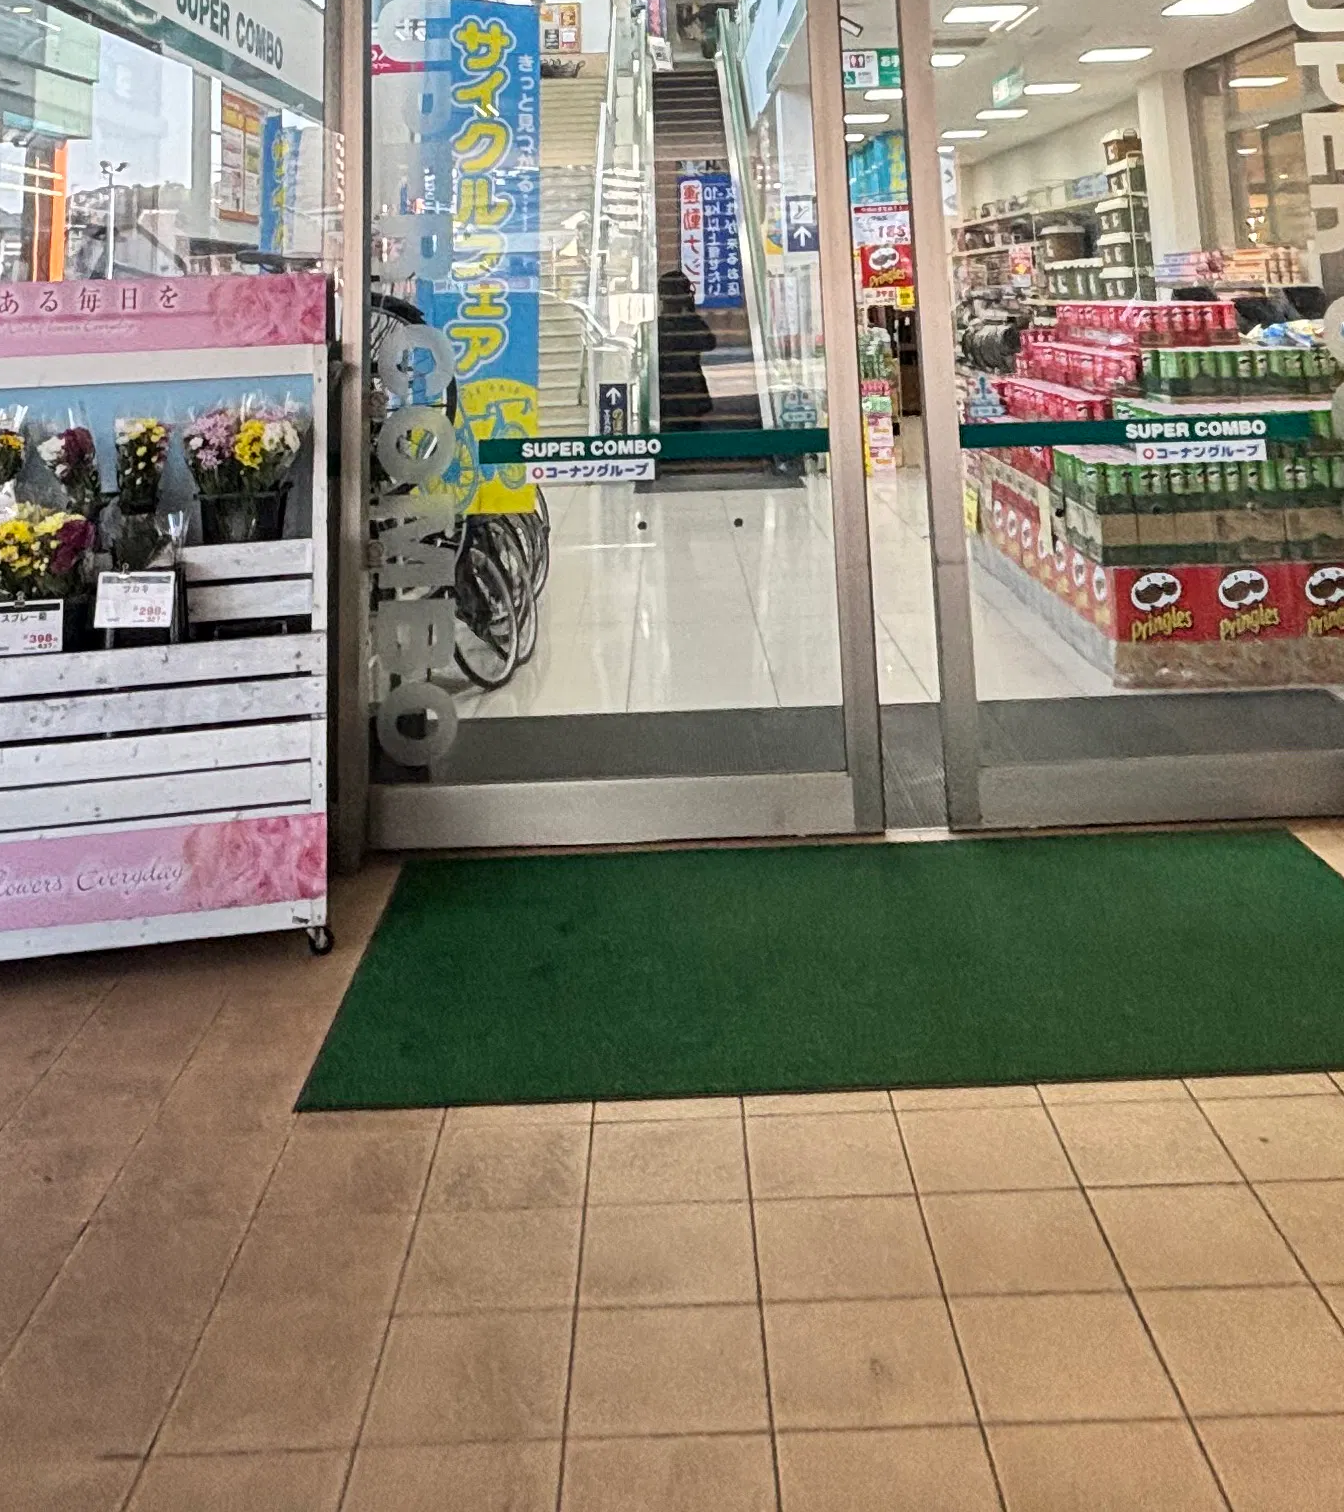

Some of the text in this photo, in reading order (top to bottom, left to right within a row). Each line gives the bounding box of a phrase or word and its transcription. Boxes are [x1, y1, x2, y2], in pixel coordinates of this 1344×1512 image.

[236, 11, 284, 70] COMBO
[1125, 420, 1267, 439] SUPER COMBO
[521, 439, 662, 458] SUPER COMBO
[1156, 444, 1259, 459] コーナングループ
[545, 462, 649, 479] コーナングループ
[1131, 606, 1193, 642] Pringles
[1219, 604, 1280, 641] Pringles
[76, 864, 184, 894] Everyday
